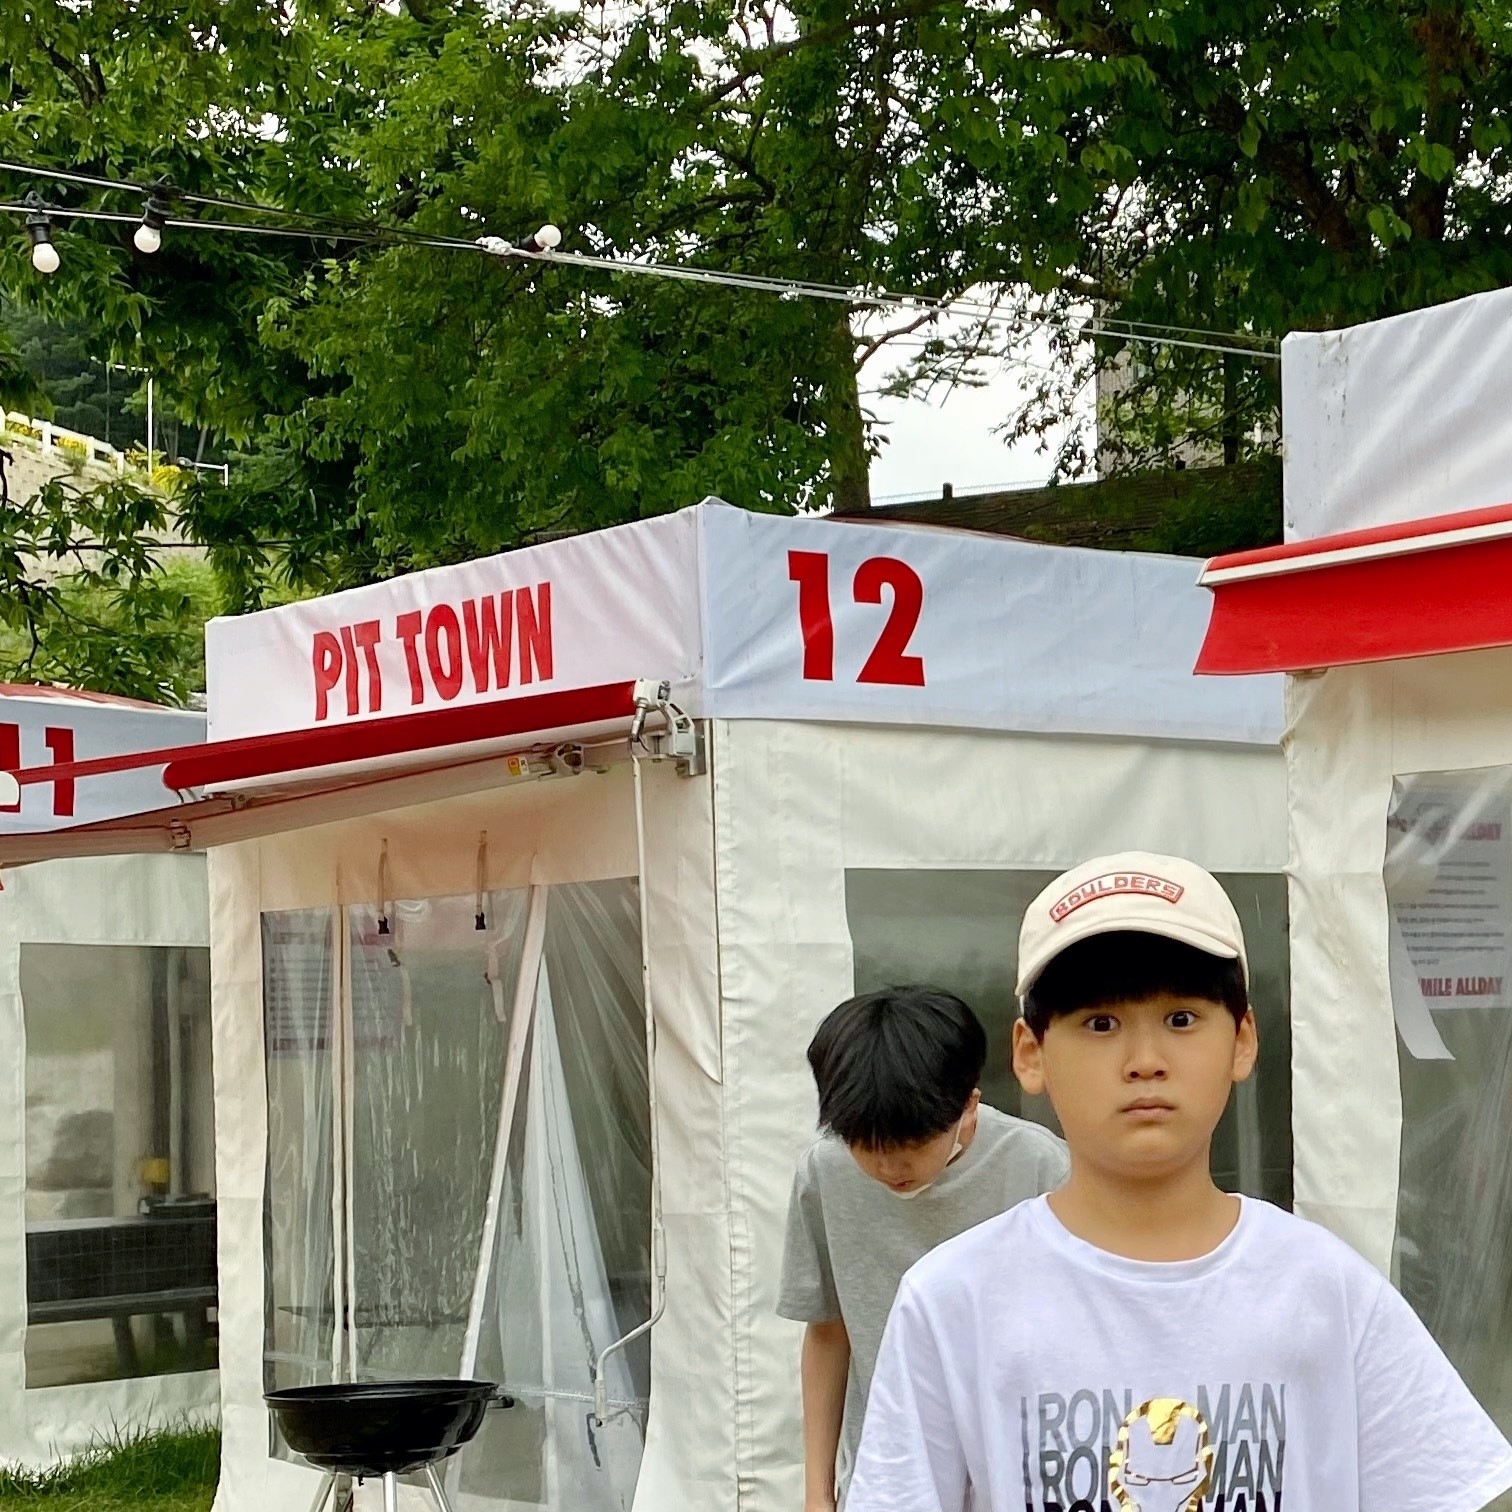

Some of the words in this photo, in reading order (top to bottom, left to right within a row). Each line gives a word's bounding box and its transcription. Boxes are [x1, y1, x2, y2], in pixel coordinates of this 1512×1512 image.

[313, 620, 381, 722] PIT
[396, 582, 554, 706] TOWN
[788, 550, 926, 687] 12
[1055, 876, 1178, 914] BOULDERS
[1418, 976, 1452, 997] MILE
[1455, 976, 1504, 996] ALLDAY
[1021, 1388, 1132, 1452] IRON
[1197, 1383, 1286, 1445] MAN
